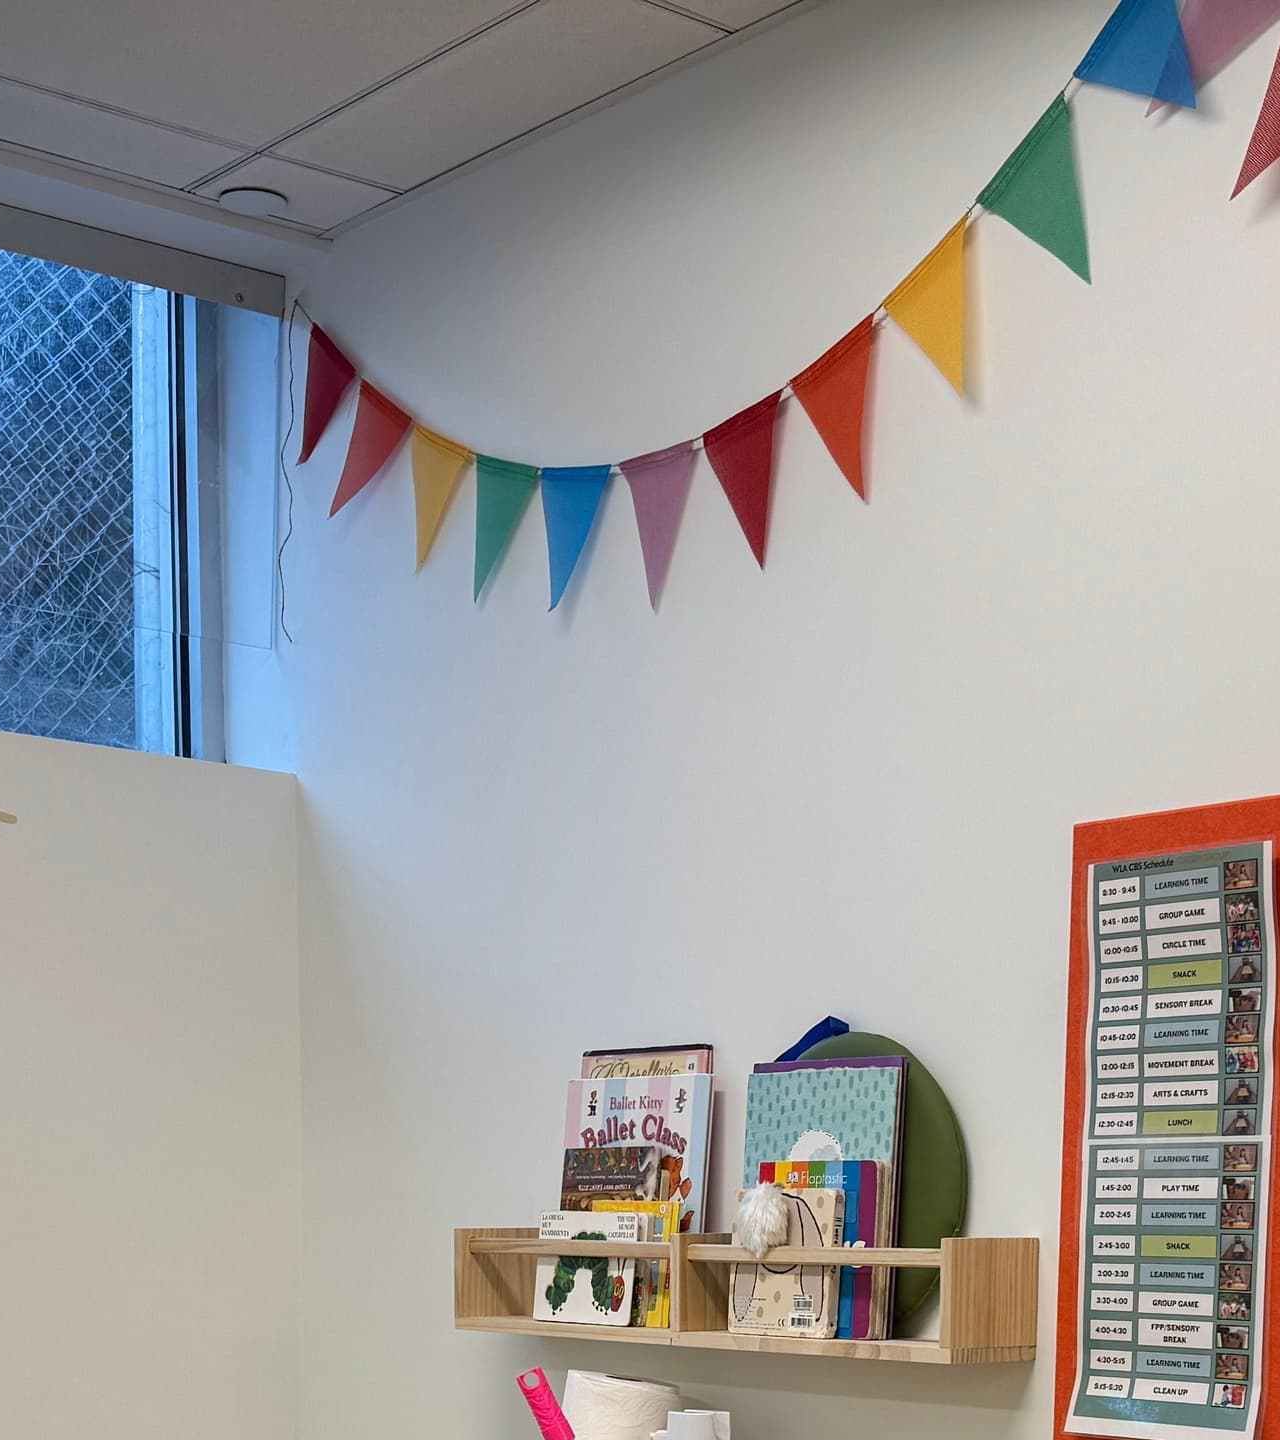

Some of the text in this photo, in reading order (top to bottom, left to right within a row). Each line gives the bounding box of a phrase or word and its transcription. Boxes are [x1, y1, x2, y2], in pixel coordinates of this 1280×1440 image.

[1128, 862, 1142, 871] CBS
[1144, 858, 1174, 870] Schedule
[1155, 877, 1208, 890] LEARNING TIME
[1159, 908, 1205, 920] GROUP GAME
[1162, 941, 1187, 949] CIRCLE
[1172, 970, 1196, 978] SNACK
[1155, 999, 1213, 1009] SENSORY BREAK
[1154, 1030, 1189, 1038] LEARNING
[1148, 1060, 1188, 1068] MOVEMENT
[610, 1095, 663, 1111] Ballet Kitty
[581, 1114, 687, 1154] Ballet Class
[801, 1170, 847, 1188] Flaptastic
[1178, 1300, 1199, 1308] GAME
[1151, 1324, 1200, 1332] FPP/SENSORY
